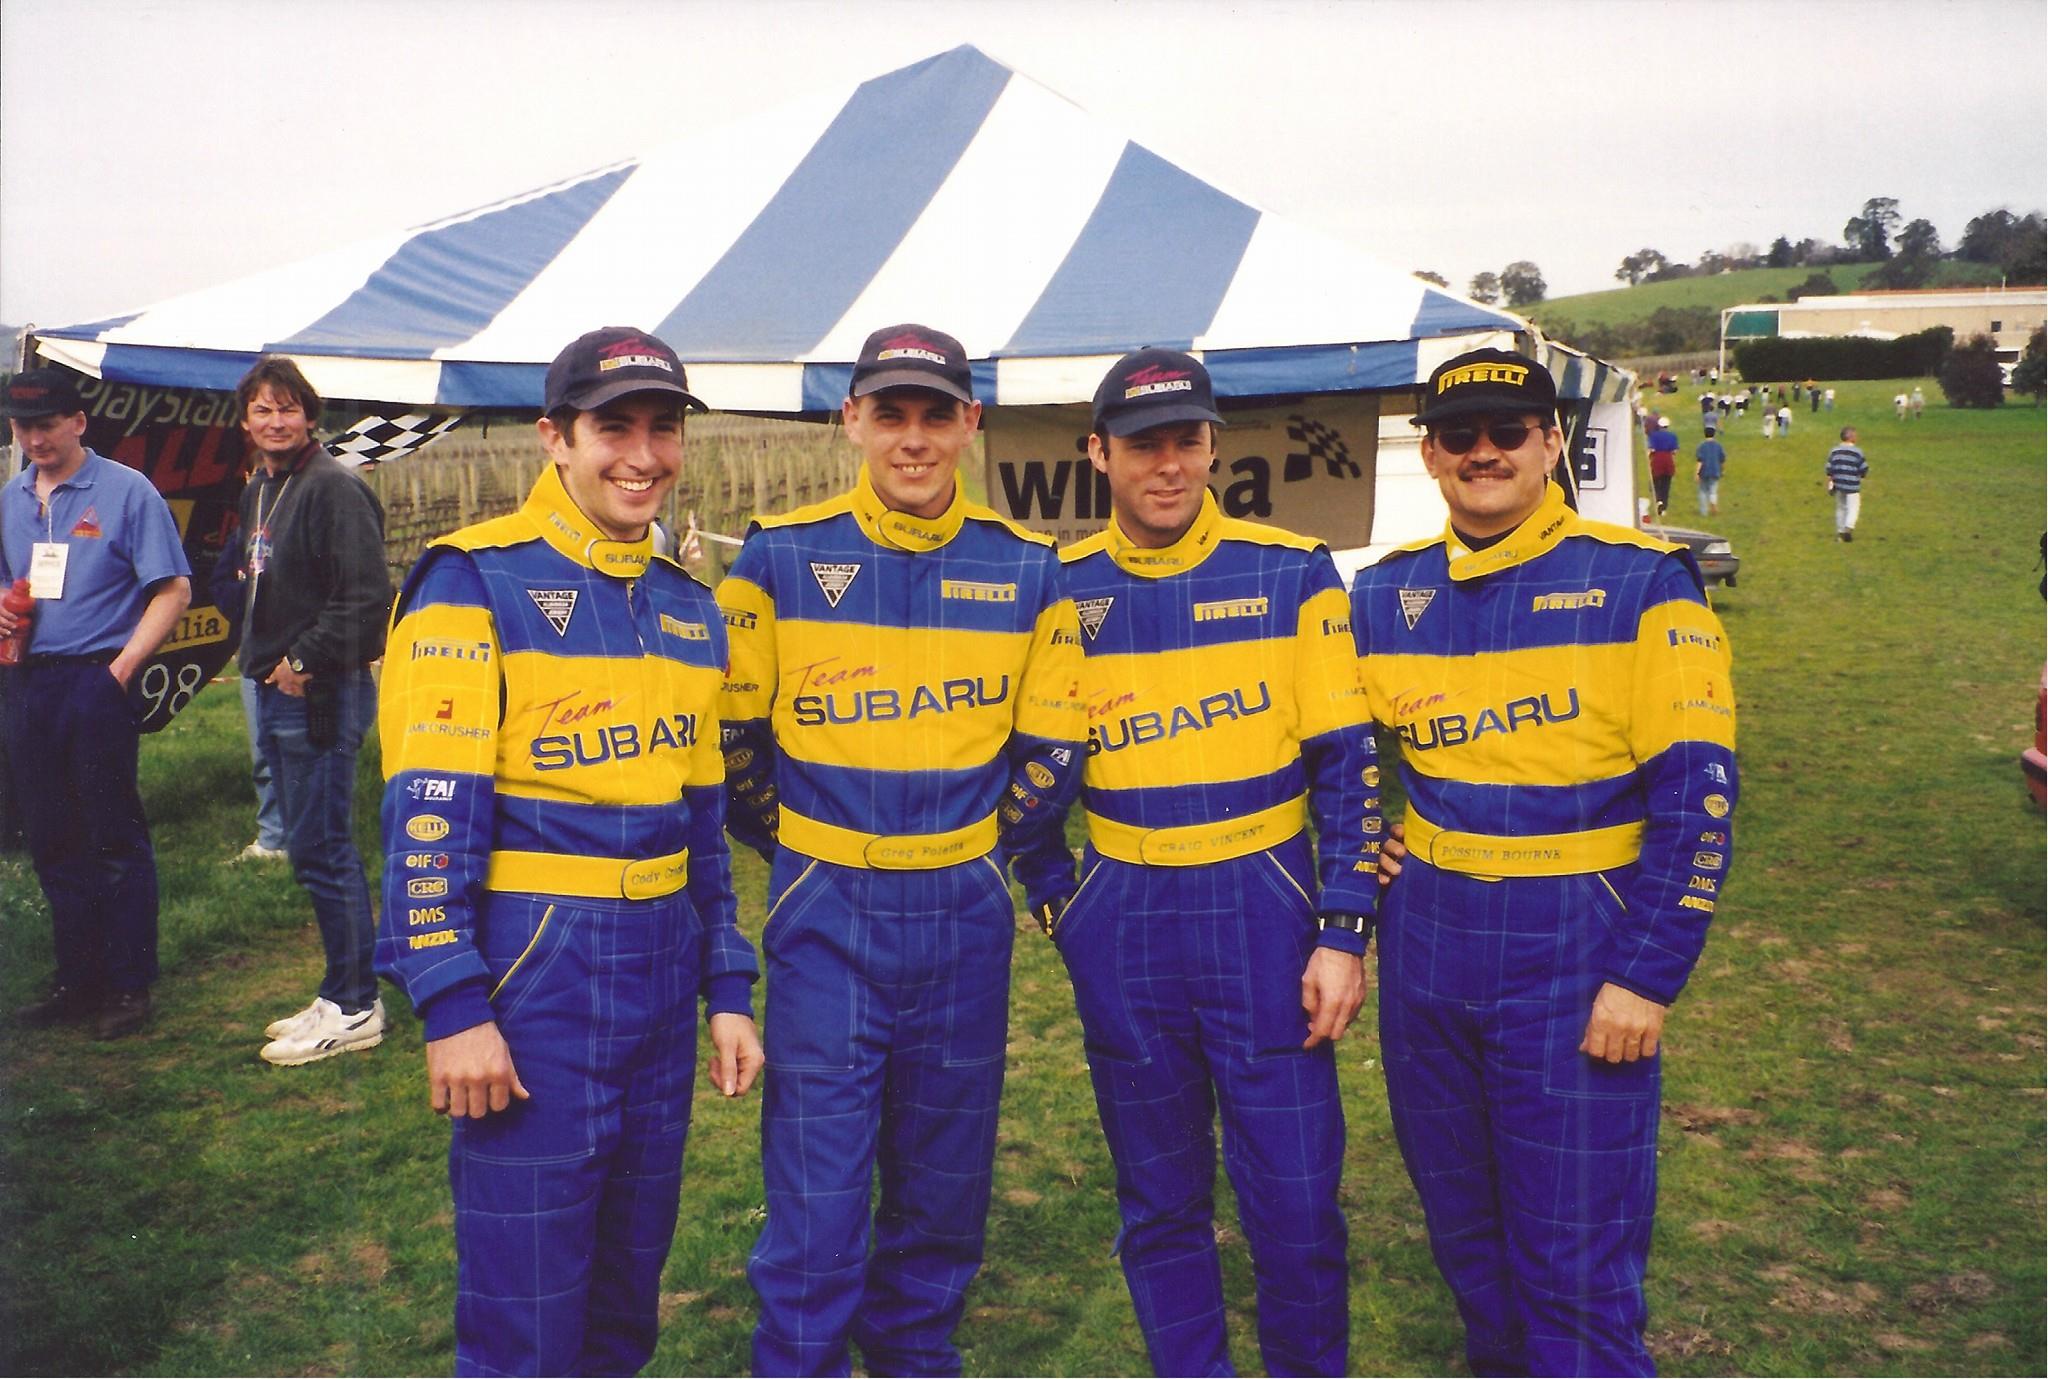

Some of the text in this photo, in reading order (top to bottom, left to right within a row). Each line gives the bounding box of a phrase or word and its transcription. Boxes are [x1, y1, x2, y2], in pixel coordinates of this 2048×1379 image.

[1438, 362, 1529, 395] PIRELLI
[814, 565, 856, 574] VANTAGE
[940, 579, 1017, 602] PIRELLI
[1194, 598, 1268, 621] PIRELLI
[411, 639, 492, 663] PIRELLI
[787, 656, 876, 698] Team
[141, 663, 202, 723] 98
[793, 674, 1009, 726] SUBARU
[524, 689, 622, 757] Team
[425, 779, 457, 797] FAI
[1158, 824, 1265, 853] CRAIG VINCENT
[881, 847, 914, 860] Greg
[1442, 846, 1561, 861] POSSUM BOURNE
[411, 881, 444, 894] CRC
[409, 906, 446, 926] DMS
